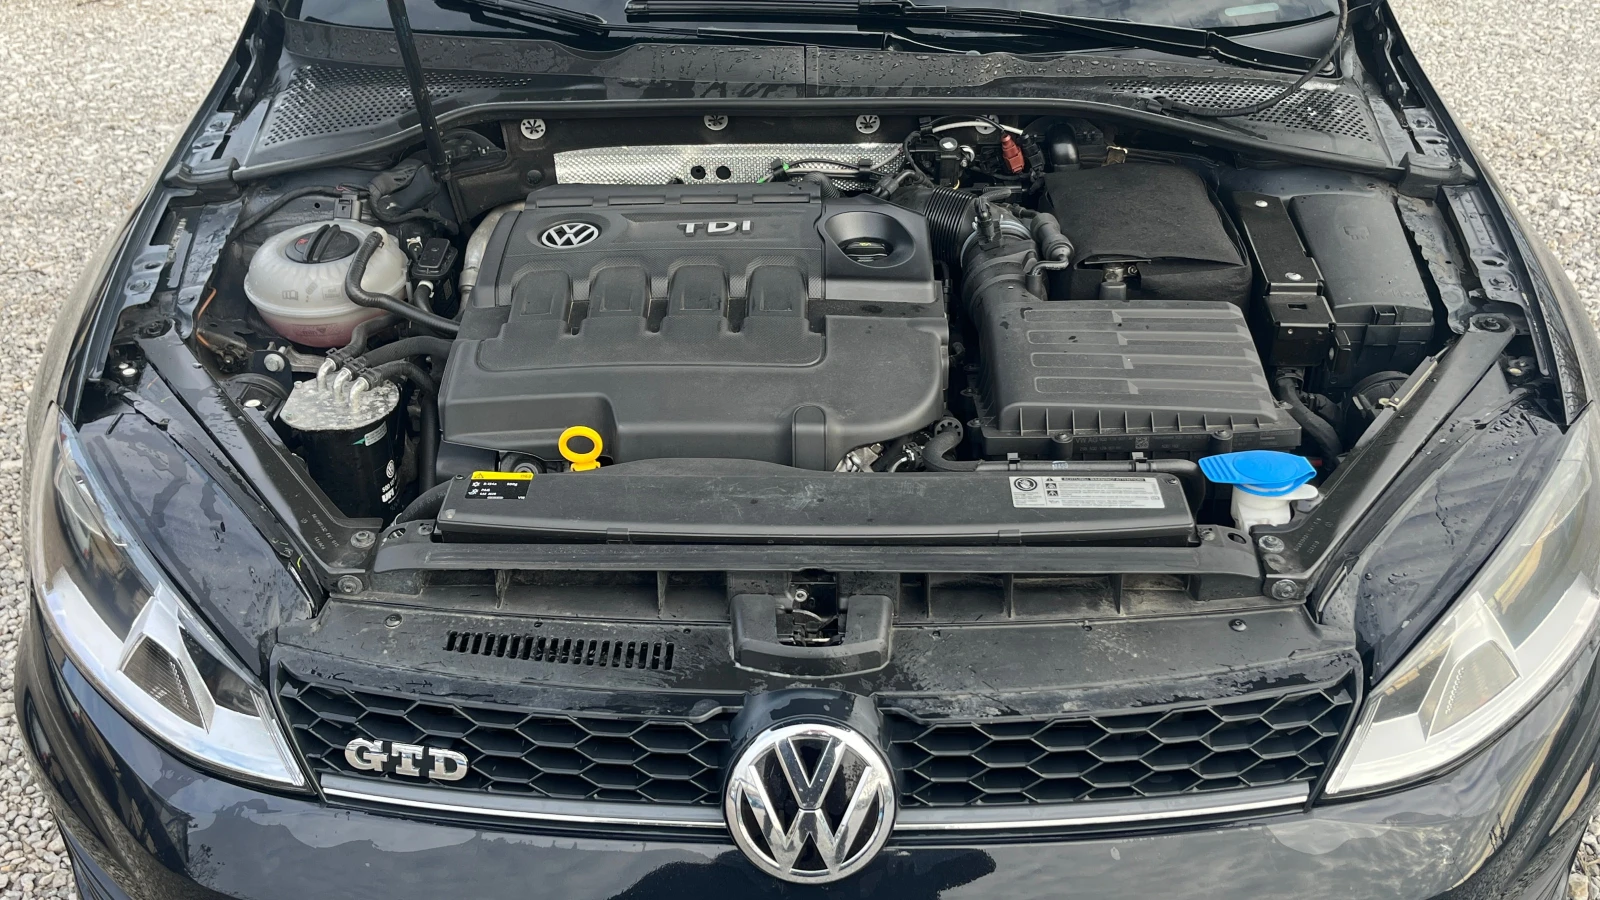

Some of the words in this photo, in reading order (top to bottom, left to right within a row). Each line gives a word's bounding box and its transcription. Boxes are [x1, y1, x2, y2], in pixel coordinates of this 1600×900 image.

[678, 220, 754, 237] TDI
[344, 738, 469, 781] GTD
[724, 722, 896, 885] VW
